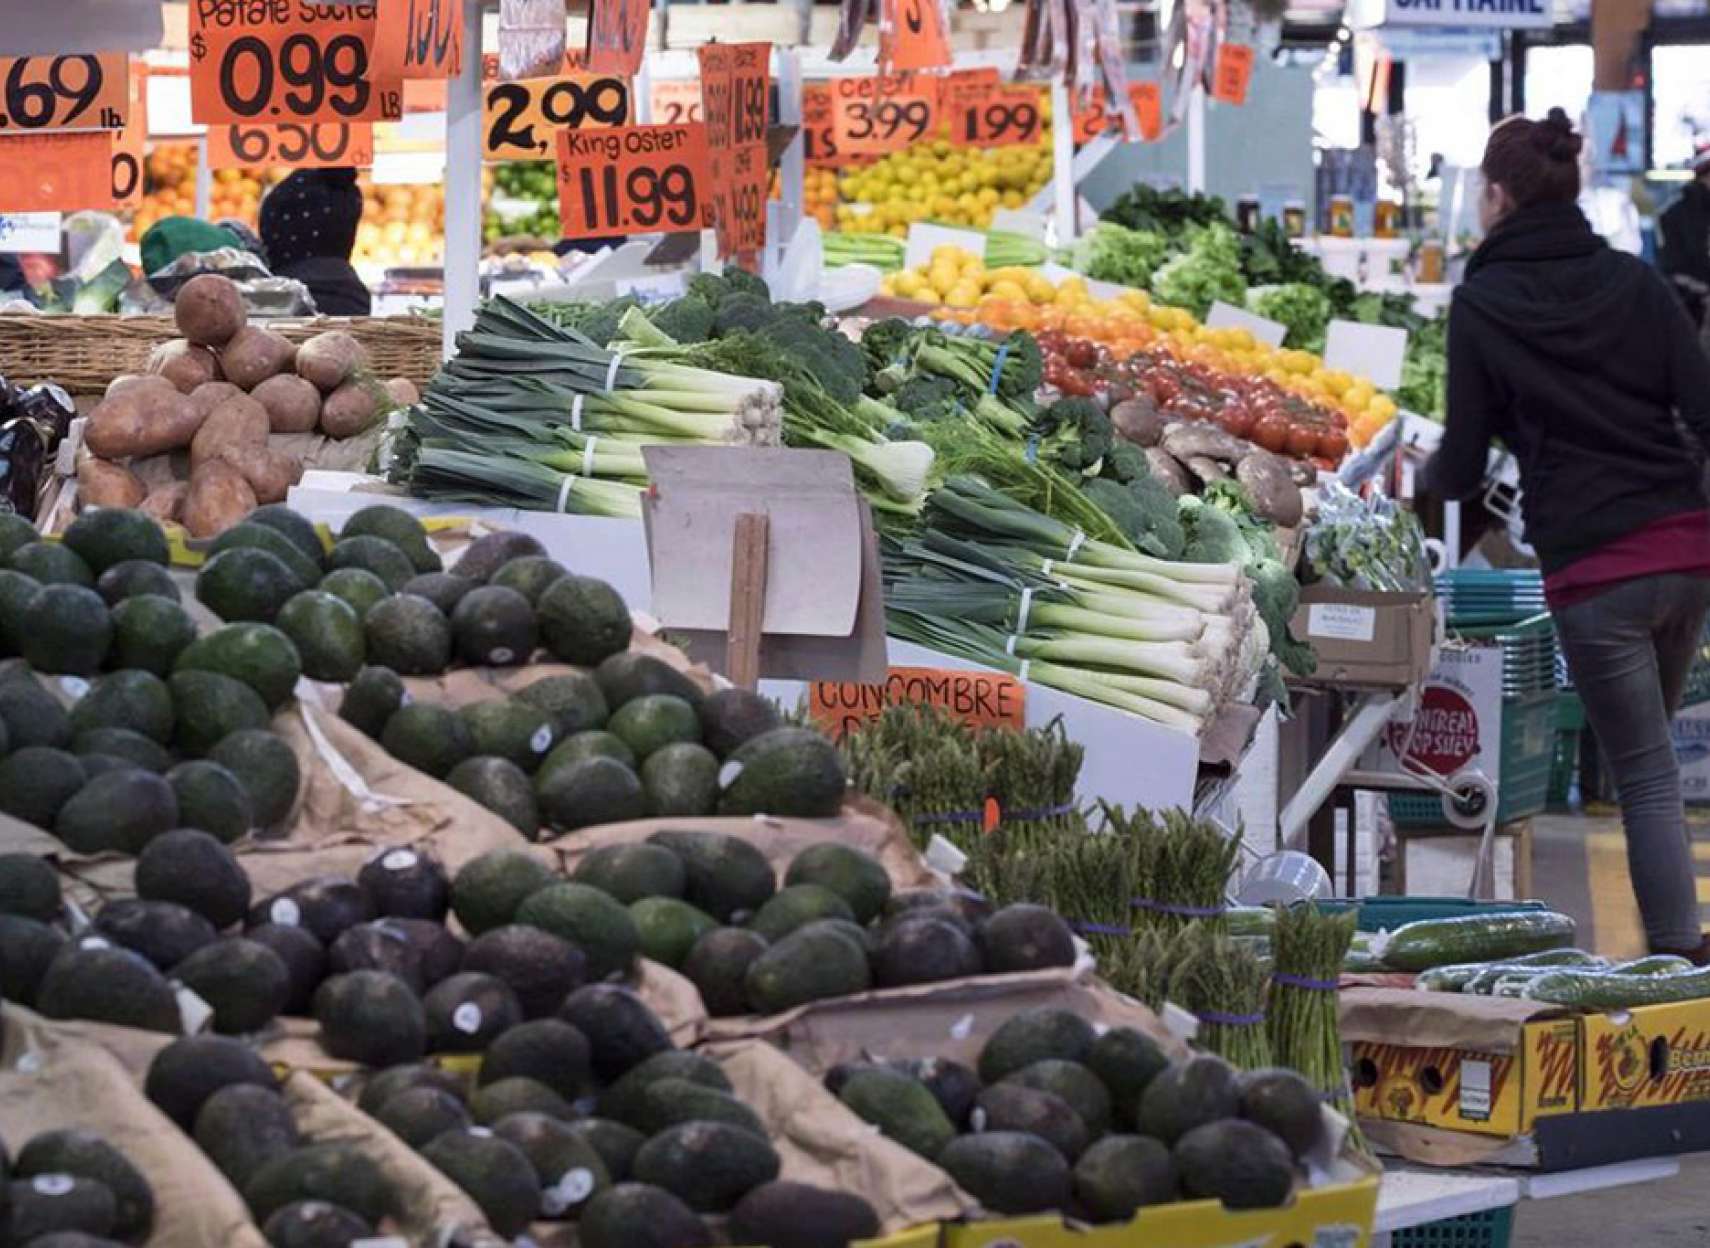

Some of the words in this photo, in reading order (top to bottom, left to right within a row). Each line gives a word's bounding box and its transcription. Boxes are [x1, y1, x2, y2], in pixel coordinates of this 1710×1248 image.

[190, 33, 208, 61] $
[219, 33, 371, 117] 0.99
[567, 131, 620, 160] King
[845, 101, 929, 142] 3.99
[579, 163, 697, 231] 11.99
